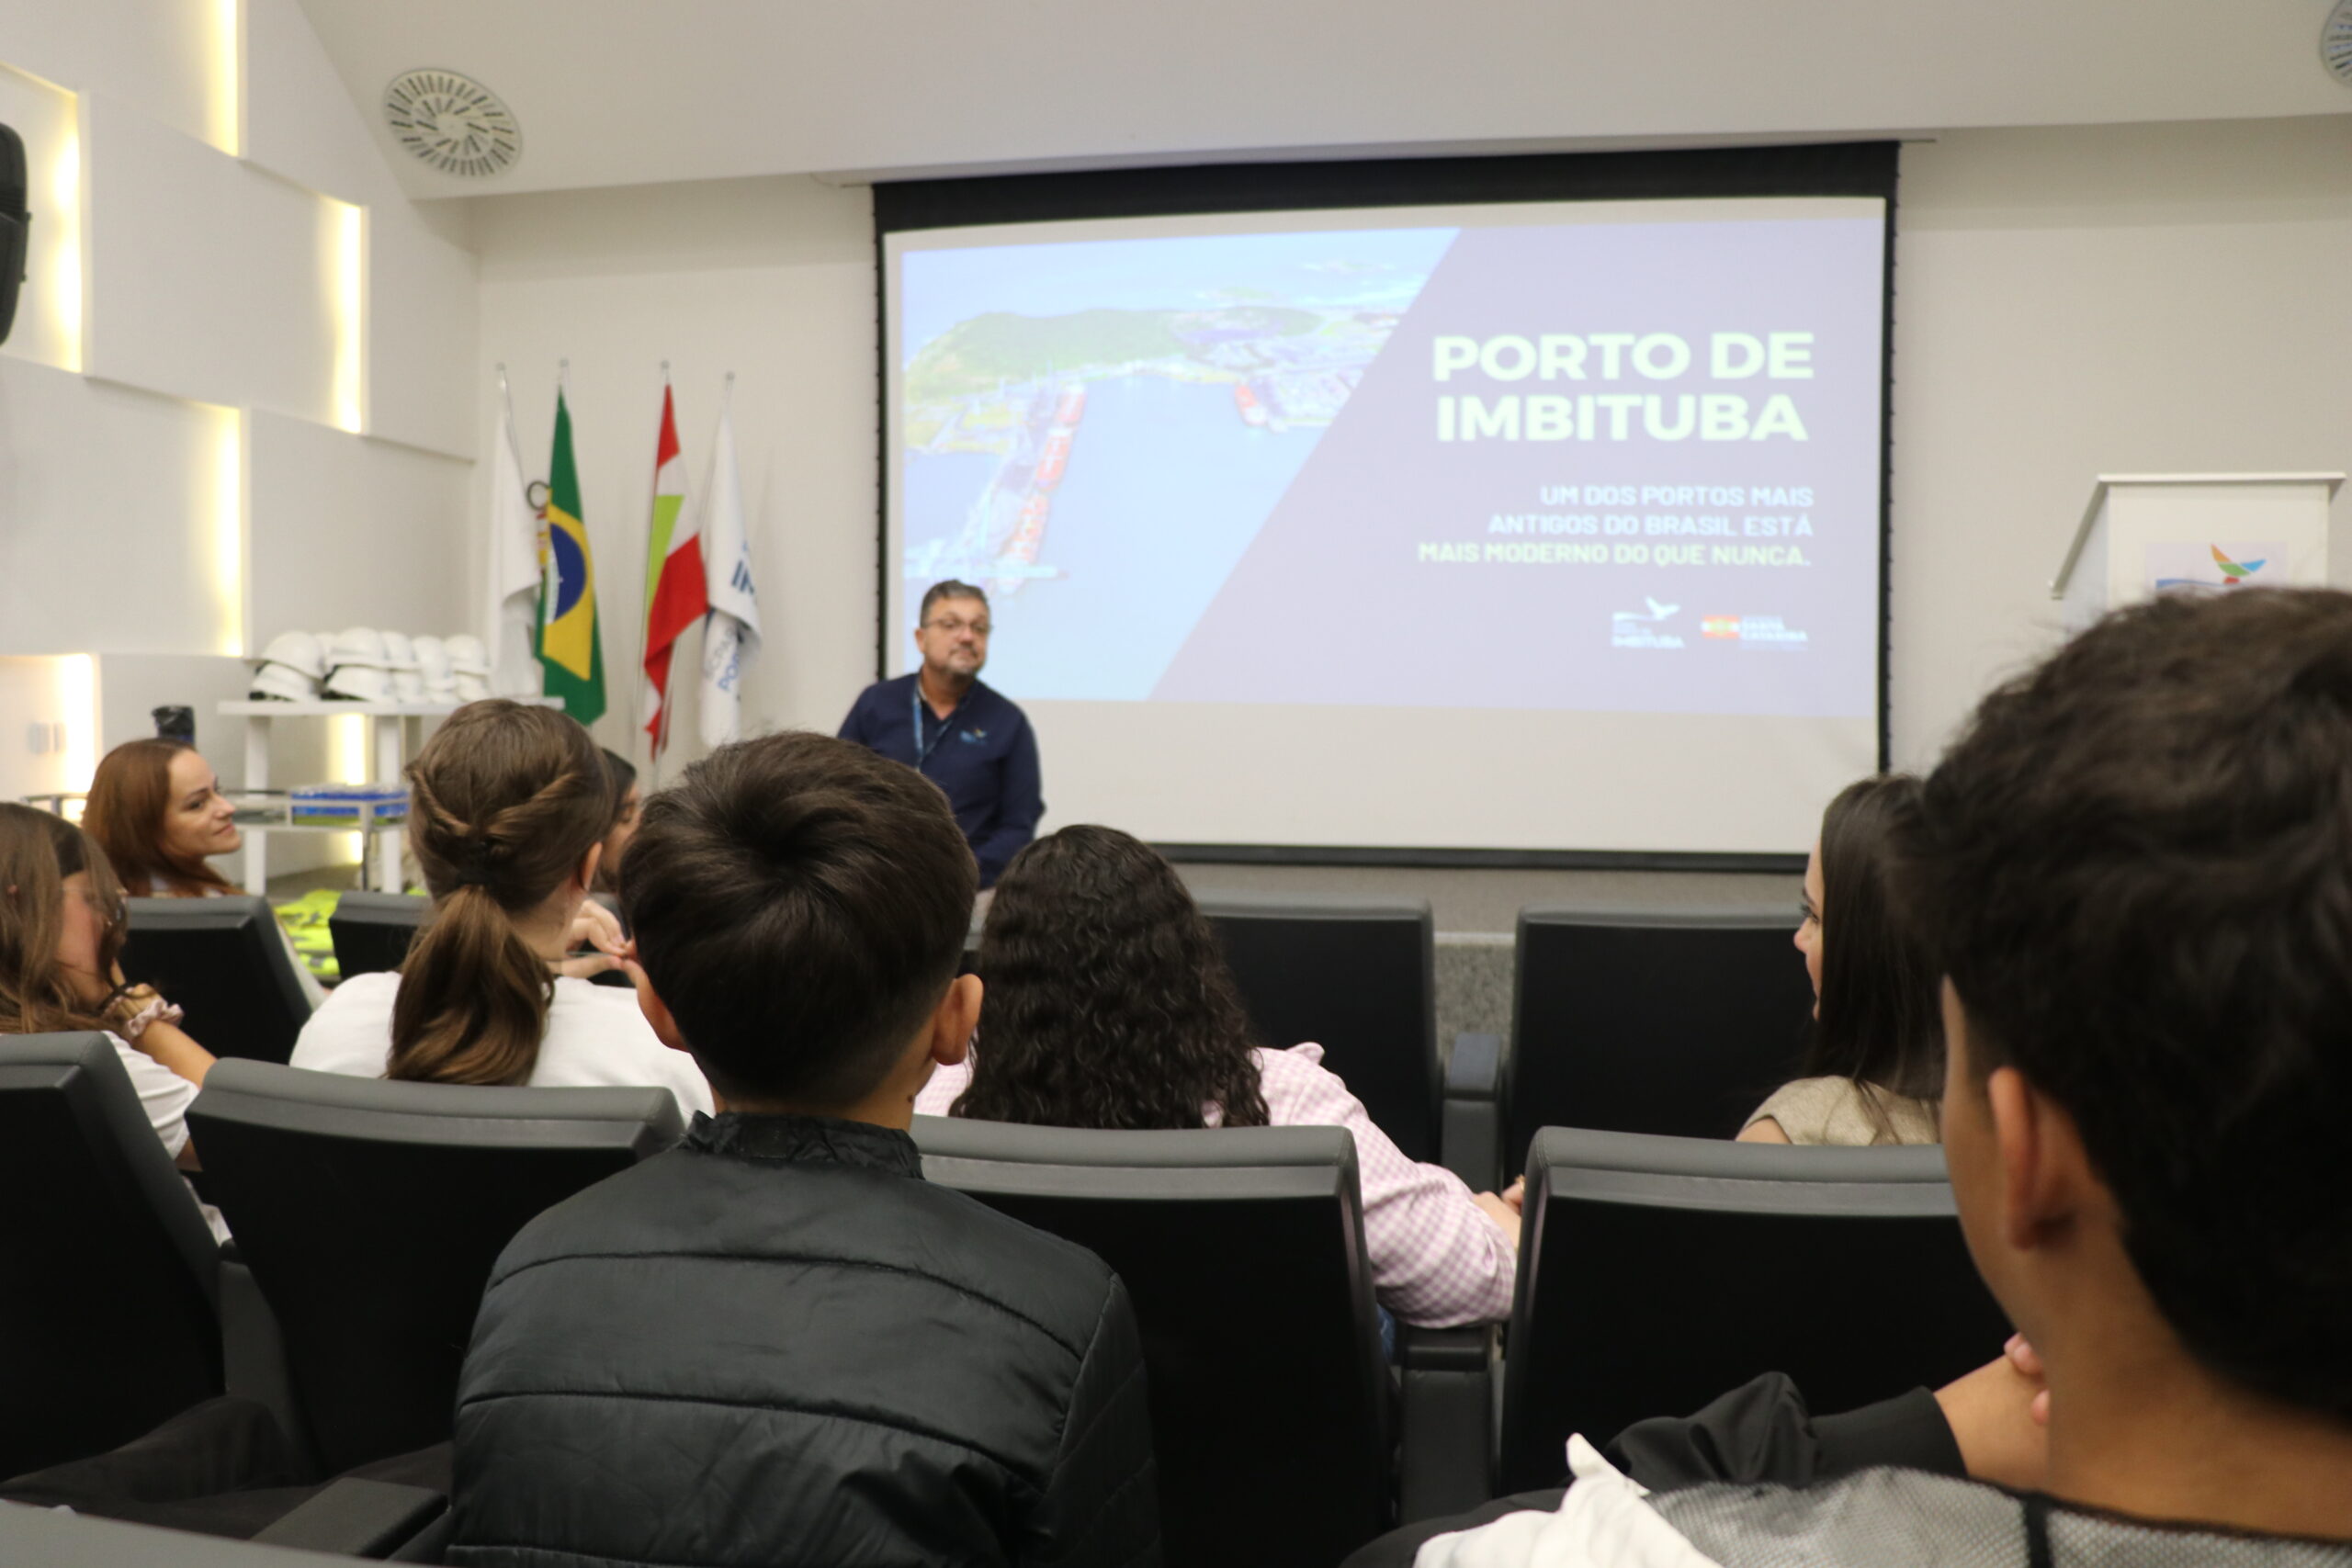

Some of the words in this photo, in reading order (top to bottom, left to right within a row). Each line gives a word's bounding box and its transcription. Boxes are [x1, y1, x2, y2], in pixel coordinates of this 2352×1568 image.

[1433, 333, 1691, 381] PORTO
[1710, 332, 1815, 379] DE
[1437, 393, 1809, 442] IMBITUBA
[1541, 485, 1578, 506] UM
[1584, 485, 1636, 506] DOS
[1642, 486, 1745, 506] PORTOS
[1750, 486, 1814, 507] MAIS
[1488, 514, 1599, 536] ANTIGOS
[1604, 514, 1639, 536] DO
[1645, 514, 1737, 536] BRASIL
[1744, 513, 1814, 536] ESTÁ
[1418, 543, 1479, 563] MAIS
[1485, 543, 1609, 564] MODERNO
[1613, 544, 1649, 565] DO
[1655, 544, 1706, 568] QUE
[1711, 546, 1812, 567] NUNCA.
